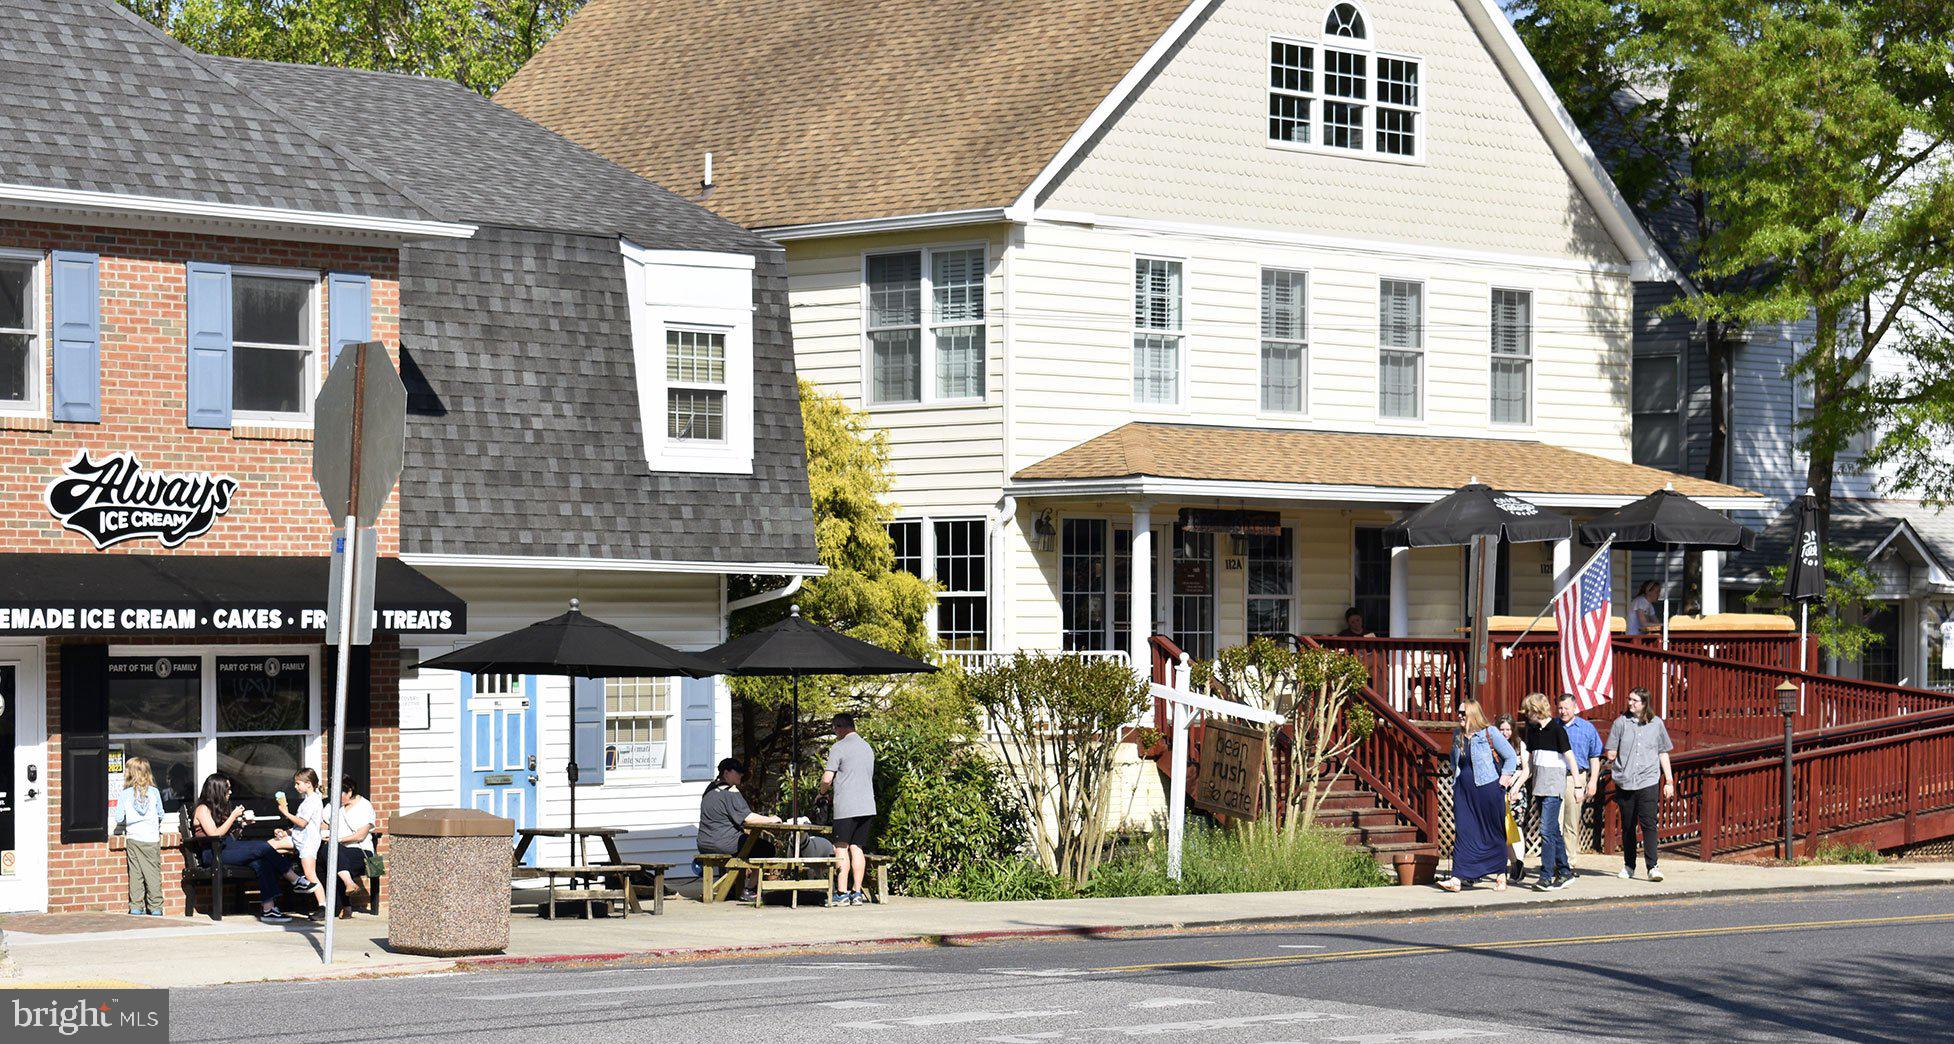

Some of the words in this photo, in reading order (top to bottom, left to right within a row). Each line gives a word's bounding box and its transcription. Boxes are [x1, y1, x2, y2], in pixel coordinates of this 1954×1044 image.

[48, 450, 238, 515] Always
[100, 510, 129, 534] ICE
[131, 511, 188, 528] CREAM
[1225, 558, 1243, 570] 112A
[80, 608, 116, 630] ICE
[120, 608, 196, 630] CREAM
[212, 608, 283, 630] CAKES
[382, 609, 453, 631] TREATS
[108, 664, 127, 672] PART
[128, 664, 139, 672] OF
[140, 664, 154, 672] THE
[173, 663, 197, 671] FAMILY
[250, 663, 263, 671] THE
[281, 663, 306, 671] FAMILY
[1215, 730, 1249, 759] bean
[1212, 761, 1247, 784] rush
[1223, 786, 1252, 811] cafe
